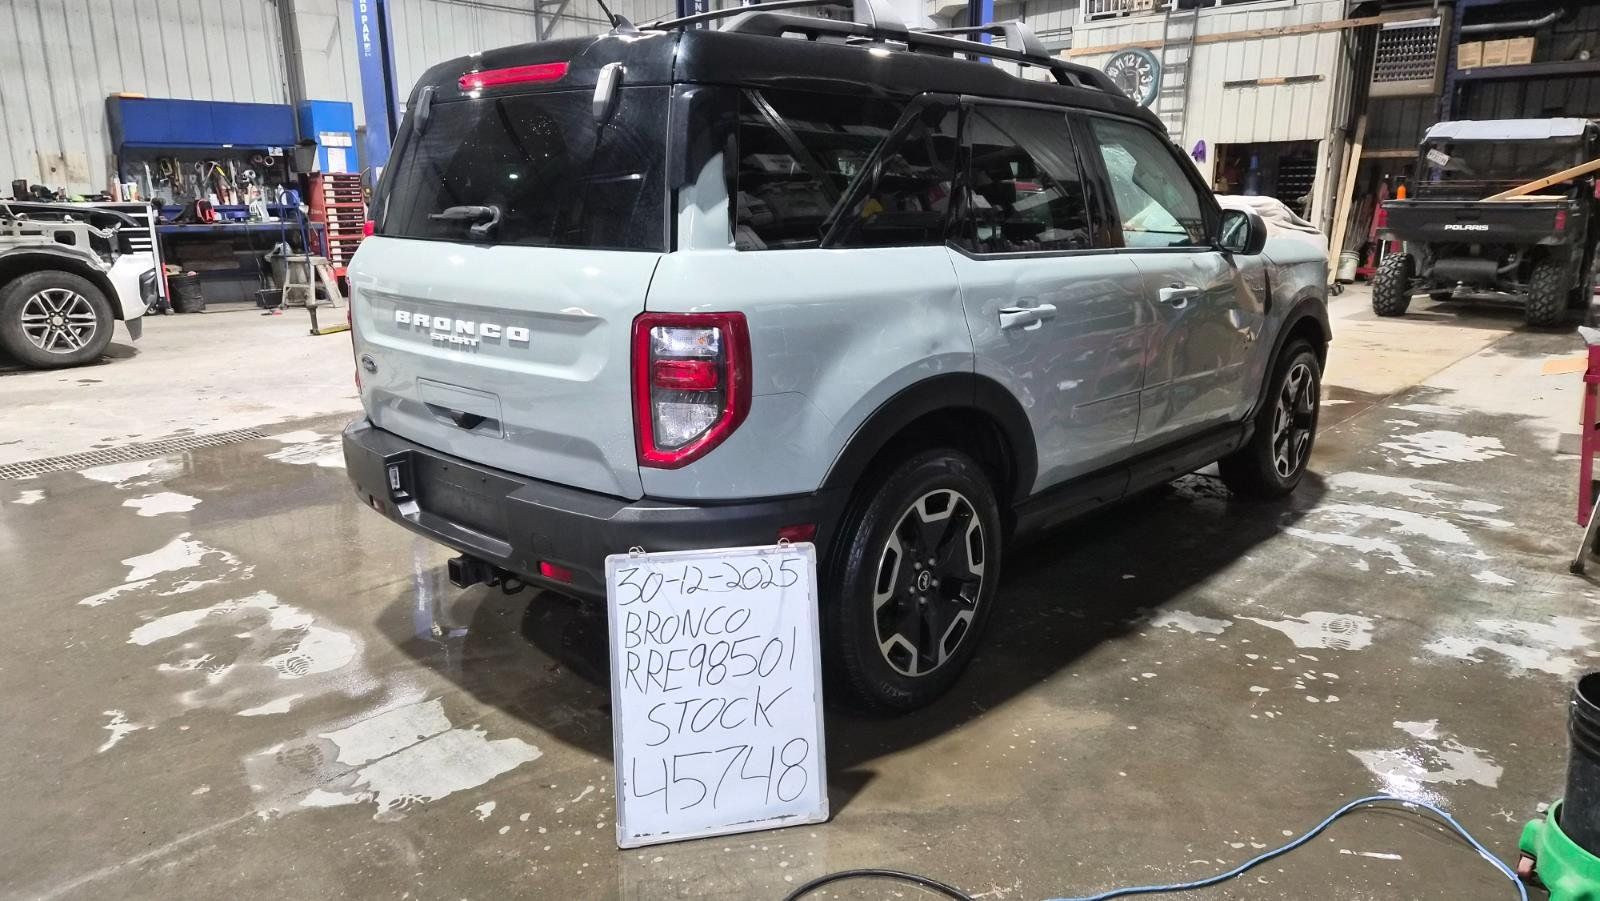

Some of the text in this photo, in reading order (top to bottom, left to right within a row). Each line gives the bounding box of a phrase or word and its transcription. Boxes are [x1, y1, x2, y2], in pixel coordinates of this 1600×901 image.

[1124, 54, 1136, 67] 12
[1138, 64, 1151, 75] 2
[1140, 75, 1153, 84] 3
[395, 310, 531, 342] BRONCO
[430, 332, 480, 346] SPORT
[617, 558, 801, 606] 30-12-2025
[624, 605, 751, 649] BRONCO
[625, 625, 797, 695] RRE98501
[645, 685, 792, 746] STOCK
[633, 737, 809, 815] 45748
